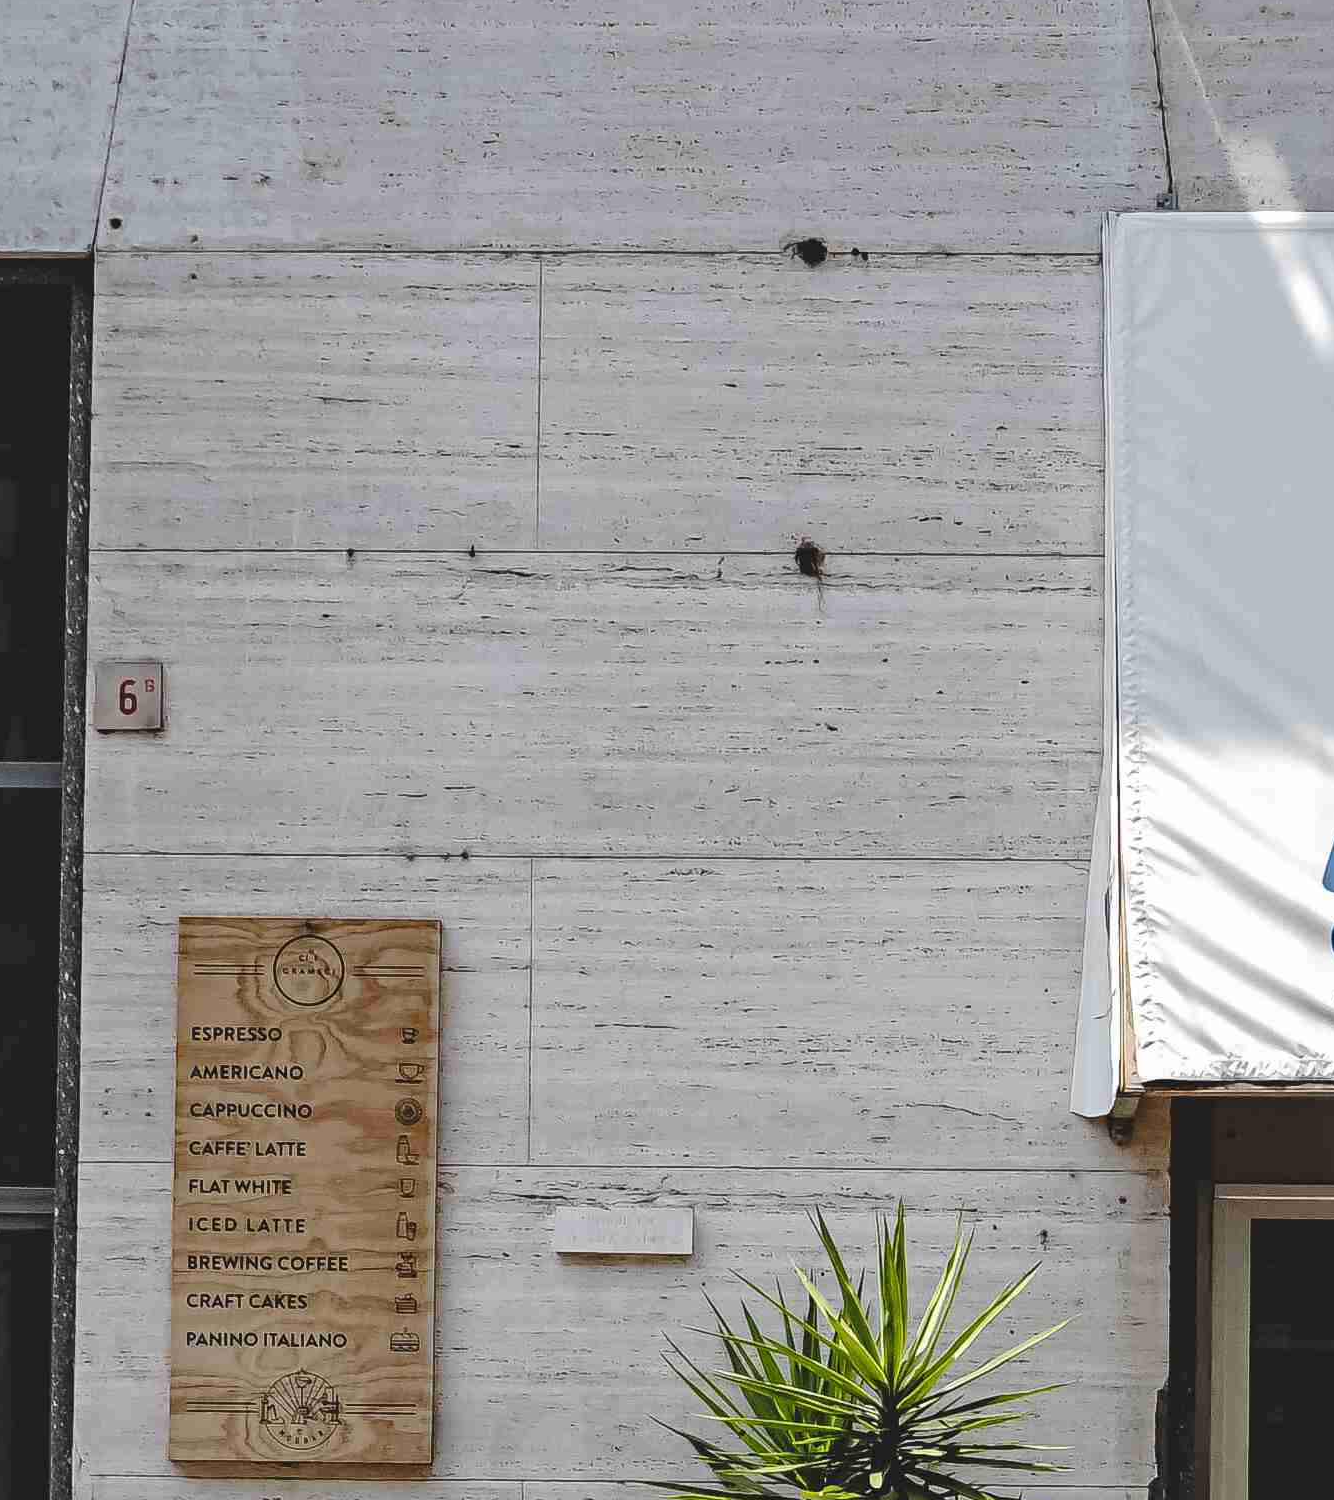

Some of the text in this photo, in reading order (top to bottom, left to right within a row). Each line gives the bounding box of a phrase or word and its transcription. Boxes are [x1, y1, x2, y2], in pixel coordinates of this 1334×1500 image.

[191, 1026, 282, 1042] ESPRESSO
[190, 1065, 304, 1080] AMERICANO
[189, 1103, 313, 1119] CAPPUCCINO
[255, 1142, 307, 1157] LATTE
[189, 1179, 292, 1195] FLAT WHITE
[188, 1217, 306, 1233] ICED LATTE
[187, 1255, 349, 1272] BREWING COFFEE
[186, 1293, 308, 1310] CRAFT CAKES
[186, 1332, 348, 1349] PANINO ITALIANO
